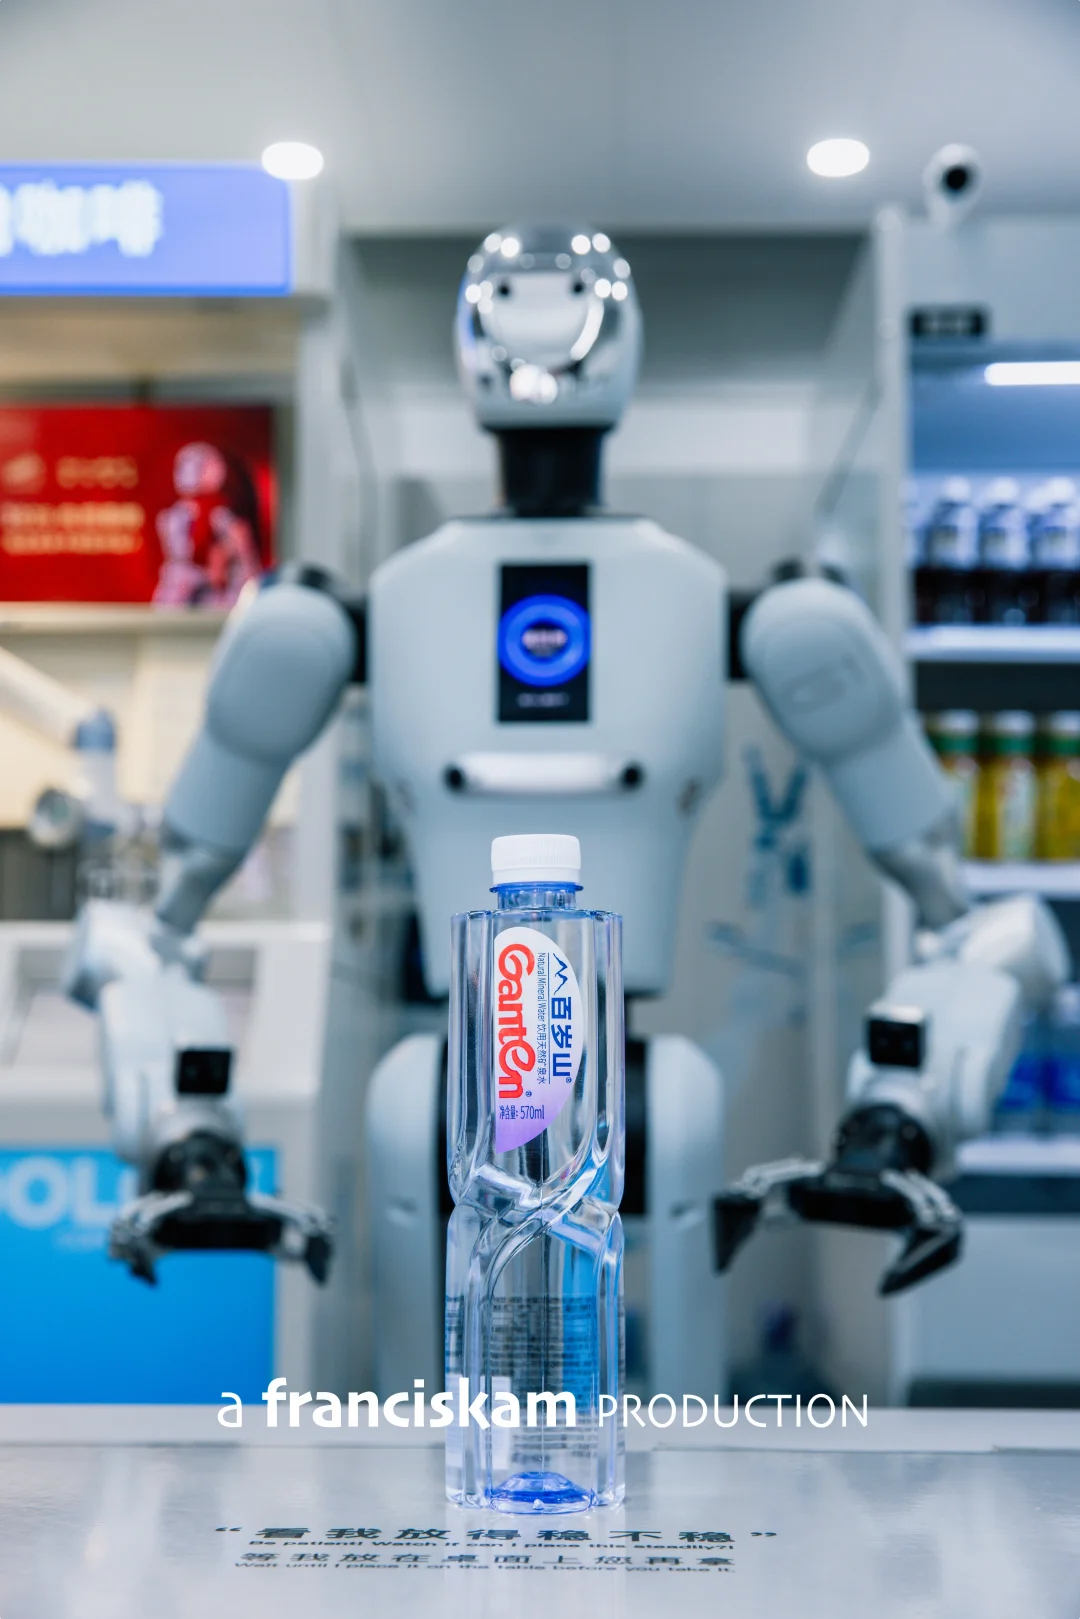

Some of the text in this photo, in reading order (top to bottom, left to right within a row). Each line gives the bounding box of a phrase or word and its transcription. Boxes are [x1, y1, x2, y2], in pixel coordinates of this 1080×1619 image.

[536, 952, 547, 1085] Natural Mineral Water 饮用天然矿泉水
[551, 997, 572, 1076] 百岁山
[520, 1105, 545, 1119] 570ml
